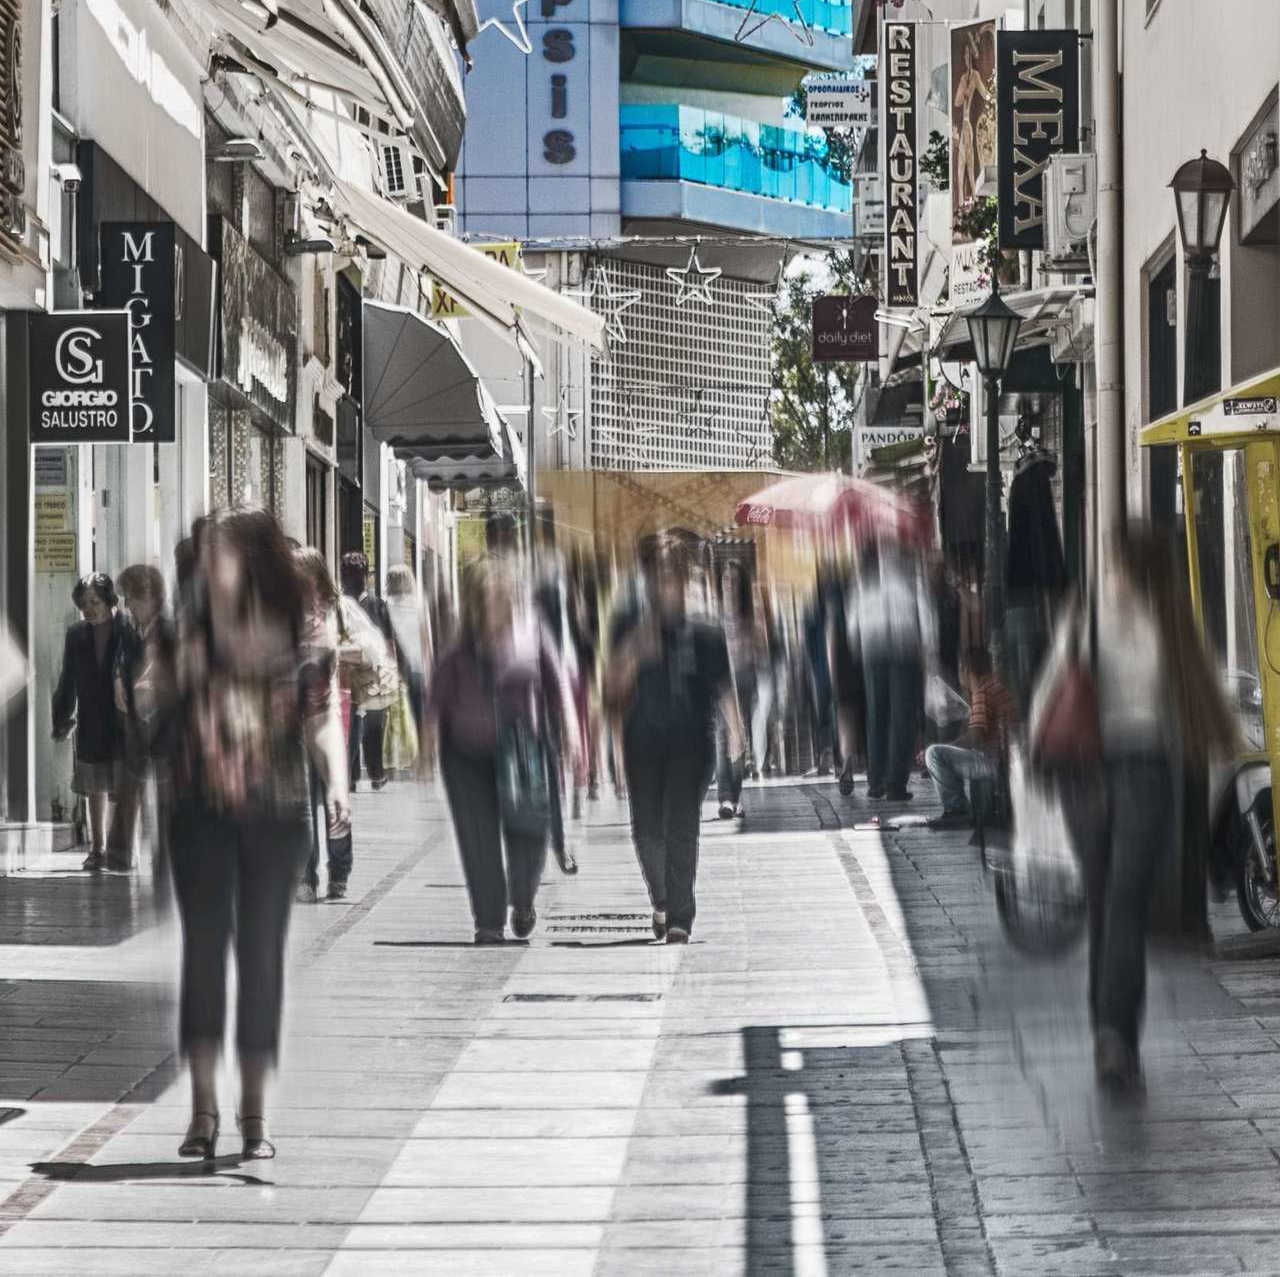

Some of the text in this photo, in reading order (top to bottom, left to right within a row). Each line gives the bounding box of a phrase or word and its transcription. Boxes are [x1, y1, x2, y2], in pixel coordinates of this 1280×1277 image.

[888, 25, 914, 286] RESTAURANT
[817, 331, 872, 347] daily diet
[41, 390, 118, 407] GIORGIO
[41, 409, 118, 428] SALUSTRO
